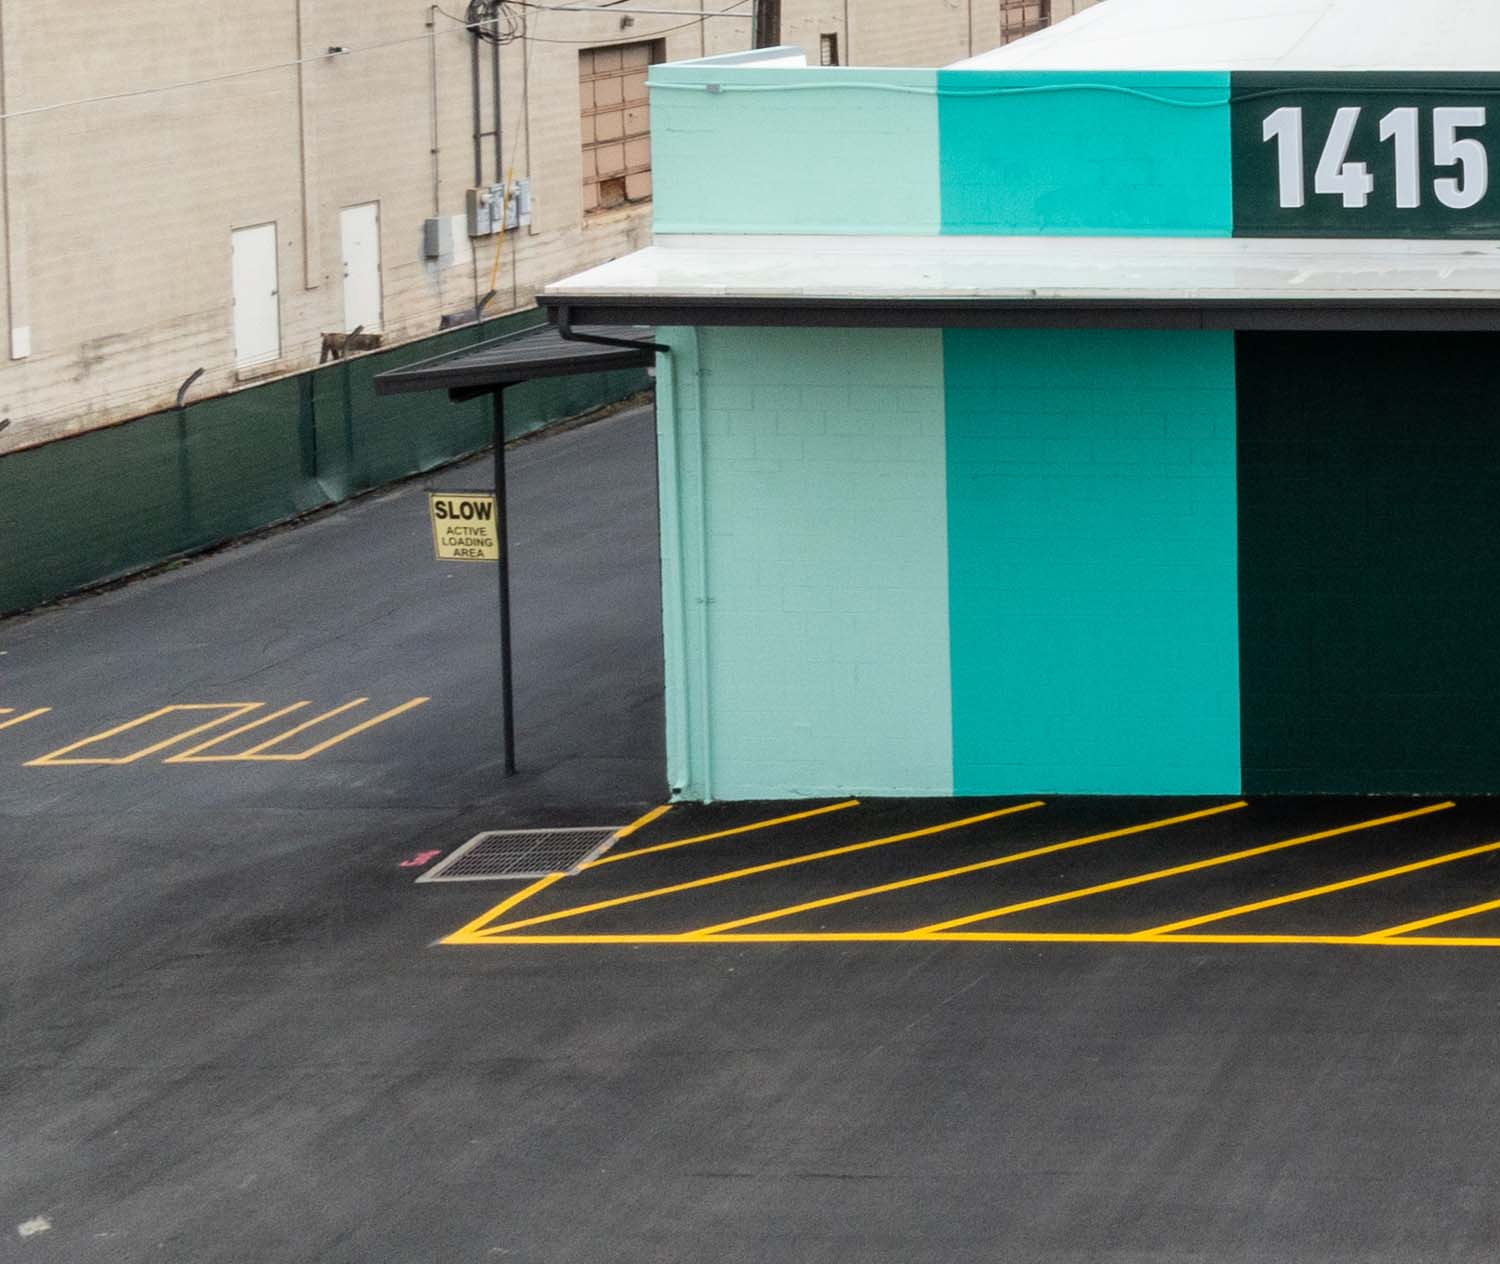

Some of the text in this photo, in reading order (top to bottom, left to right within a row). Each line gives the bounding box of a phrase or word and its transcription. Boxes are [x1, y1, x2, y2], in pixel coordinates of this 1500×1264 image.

[1262, 106, 1489, 209] 1415
[434, 500, 492, 521] SLOW
[446, 526, 487, 537] ACTIVE
[441, 537, 494, 547] LOADING
[453, 548, 485, 558] AREA
